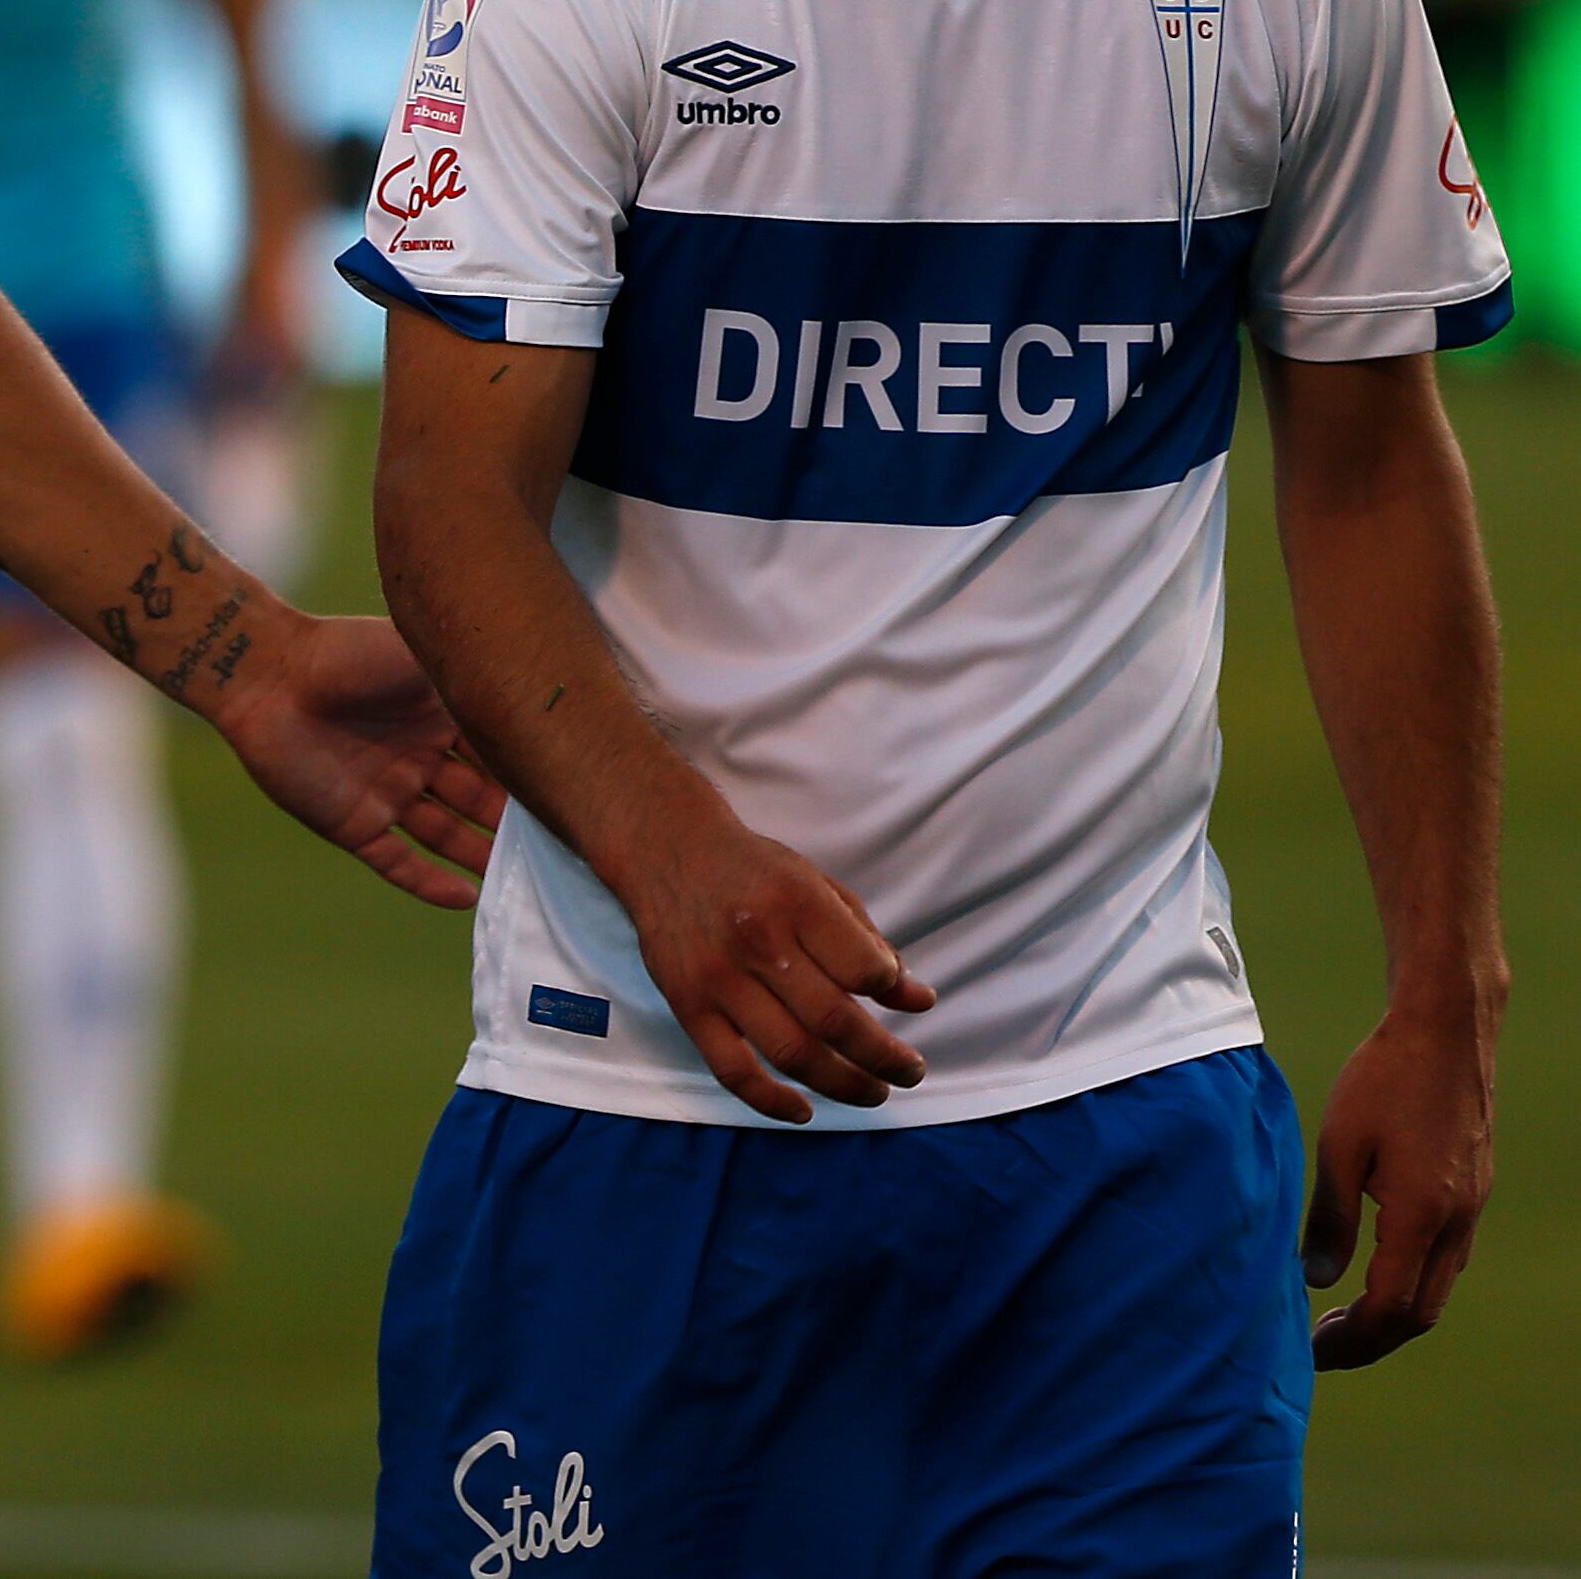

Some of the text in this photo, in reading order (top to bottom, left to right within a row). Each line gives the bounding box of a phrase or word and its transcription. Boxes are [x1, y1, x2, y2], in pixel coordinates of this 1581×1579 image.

[1165, 19, 1214, 40] U C
[675, 96, 781, 126] umbro
[376, 146, 468, 254] Soli
[453, 1429, 605, 1579] Stoli
